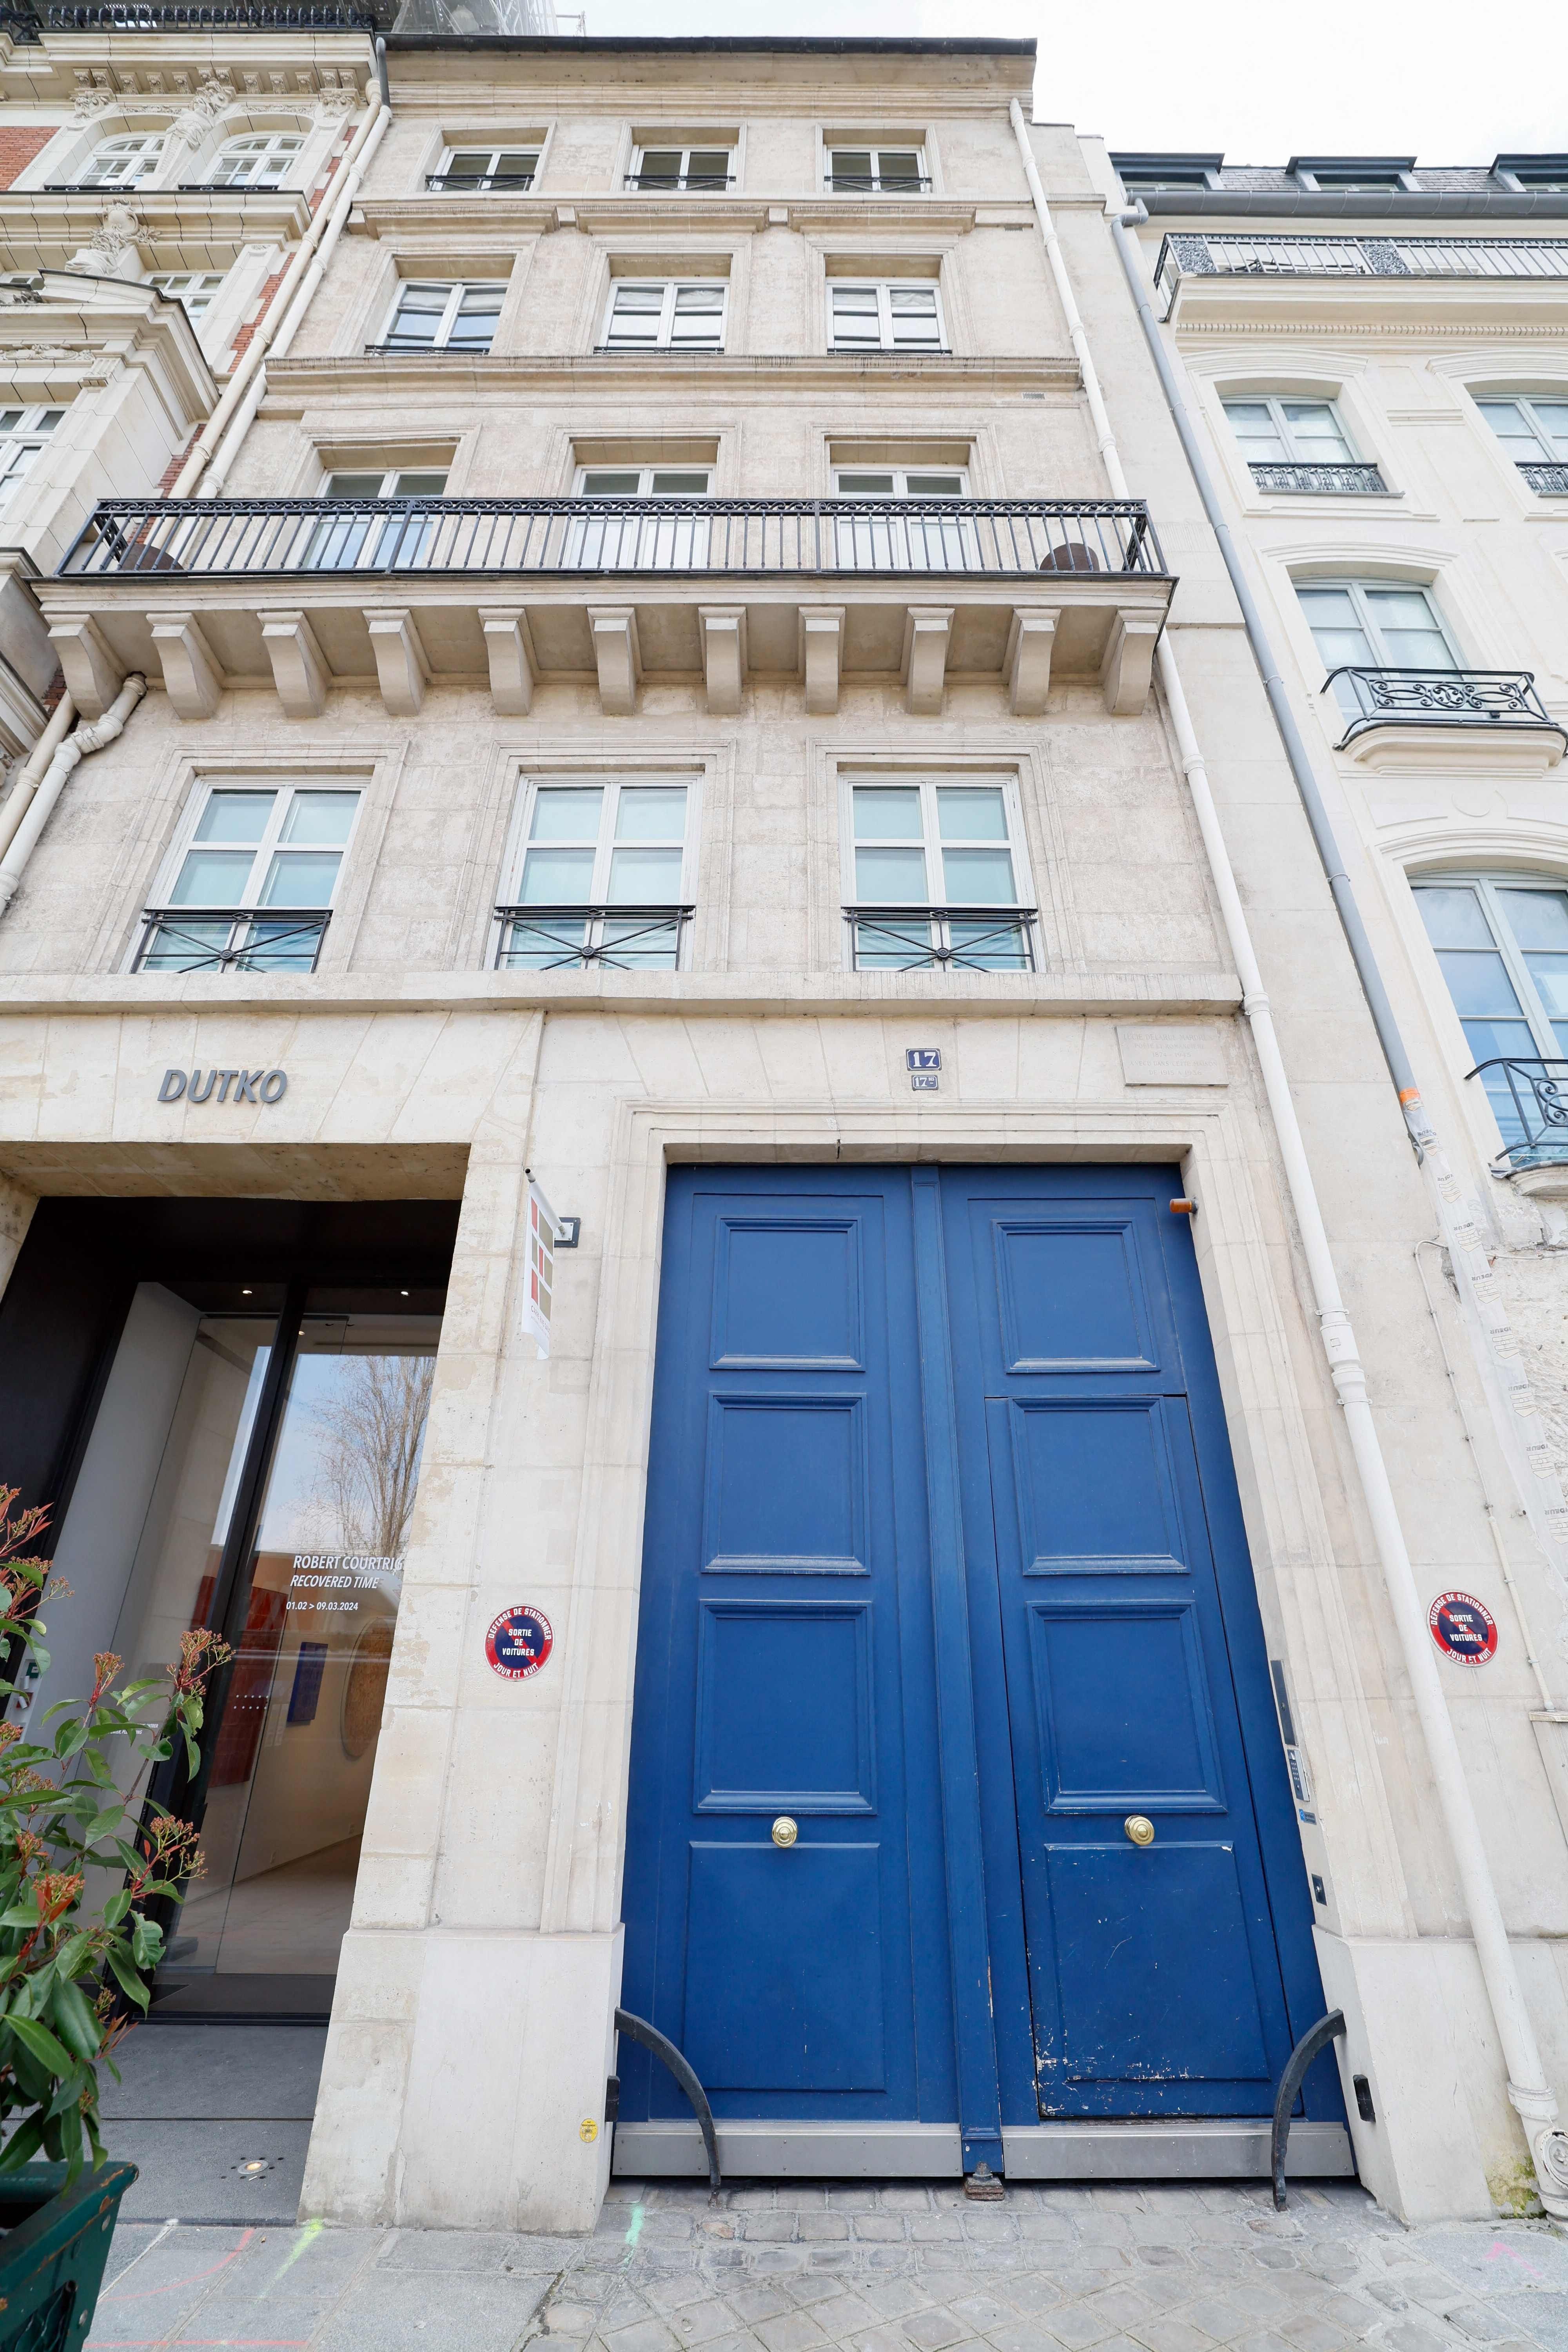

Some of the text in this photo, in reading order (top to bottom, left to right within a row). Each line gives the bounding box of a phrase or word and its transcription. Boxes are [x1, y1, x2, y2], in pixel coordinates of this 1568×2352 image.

[913, 1052, 937, 1067] 17
[157, 1069, 287, 1103] DUTKO
[915, 1077, 928, 1087] 17
[293, 1555, 341, 1569] ROBERT
[290, 1575, 379, 1589] RECOVERED TIME
[286, 1601, 307, 1610] 01.02
[316, 1602, 358, 1611] 09.03.2024
[1457, 1593, 1494, 1625] STATIONNER
[524, 1608, 552, 1640] STATIONNER
[508, 1628, 532, 1637] SORTIE
[502, 1648, 535, 1656] VOITURES
[1446, 1647, 1492, 1664] JOUR ET NUIT
[494, 1662, 511, 1677] JOUR
[523, 1662, 539, 1677] NUIT
